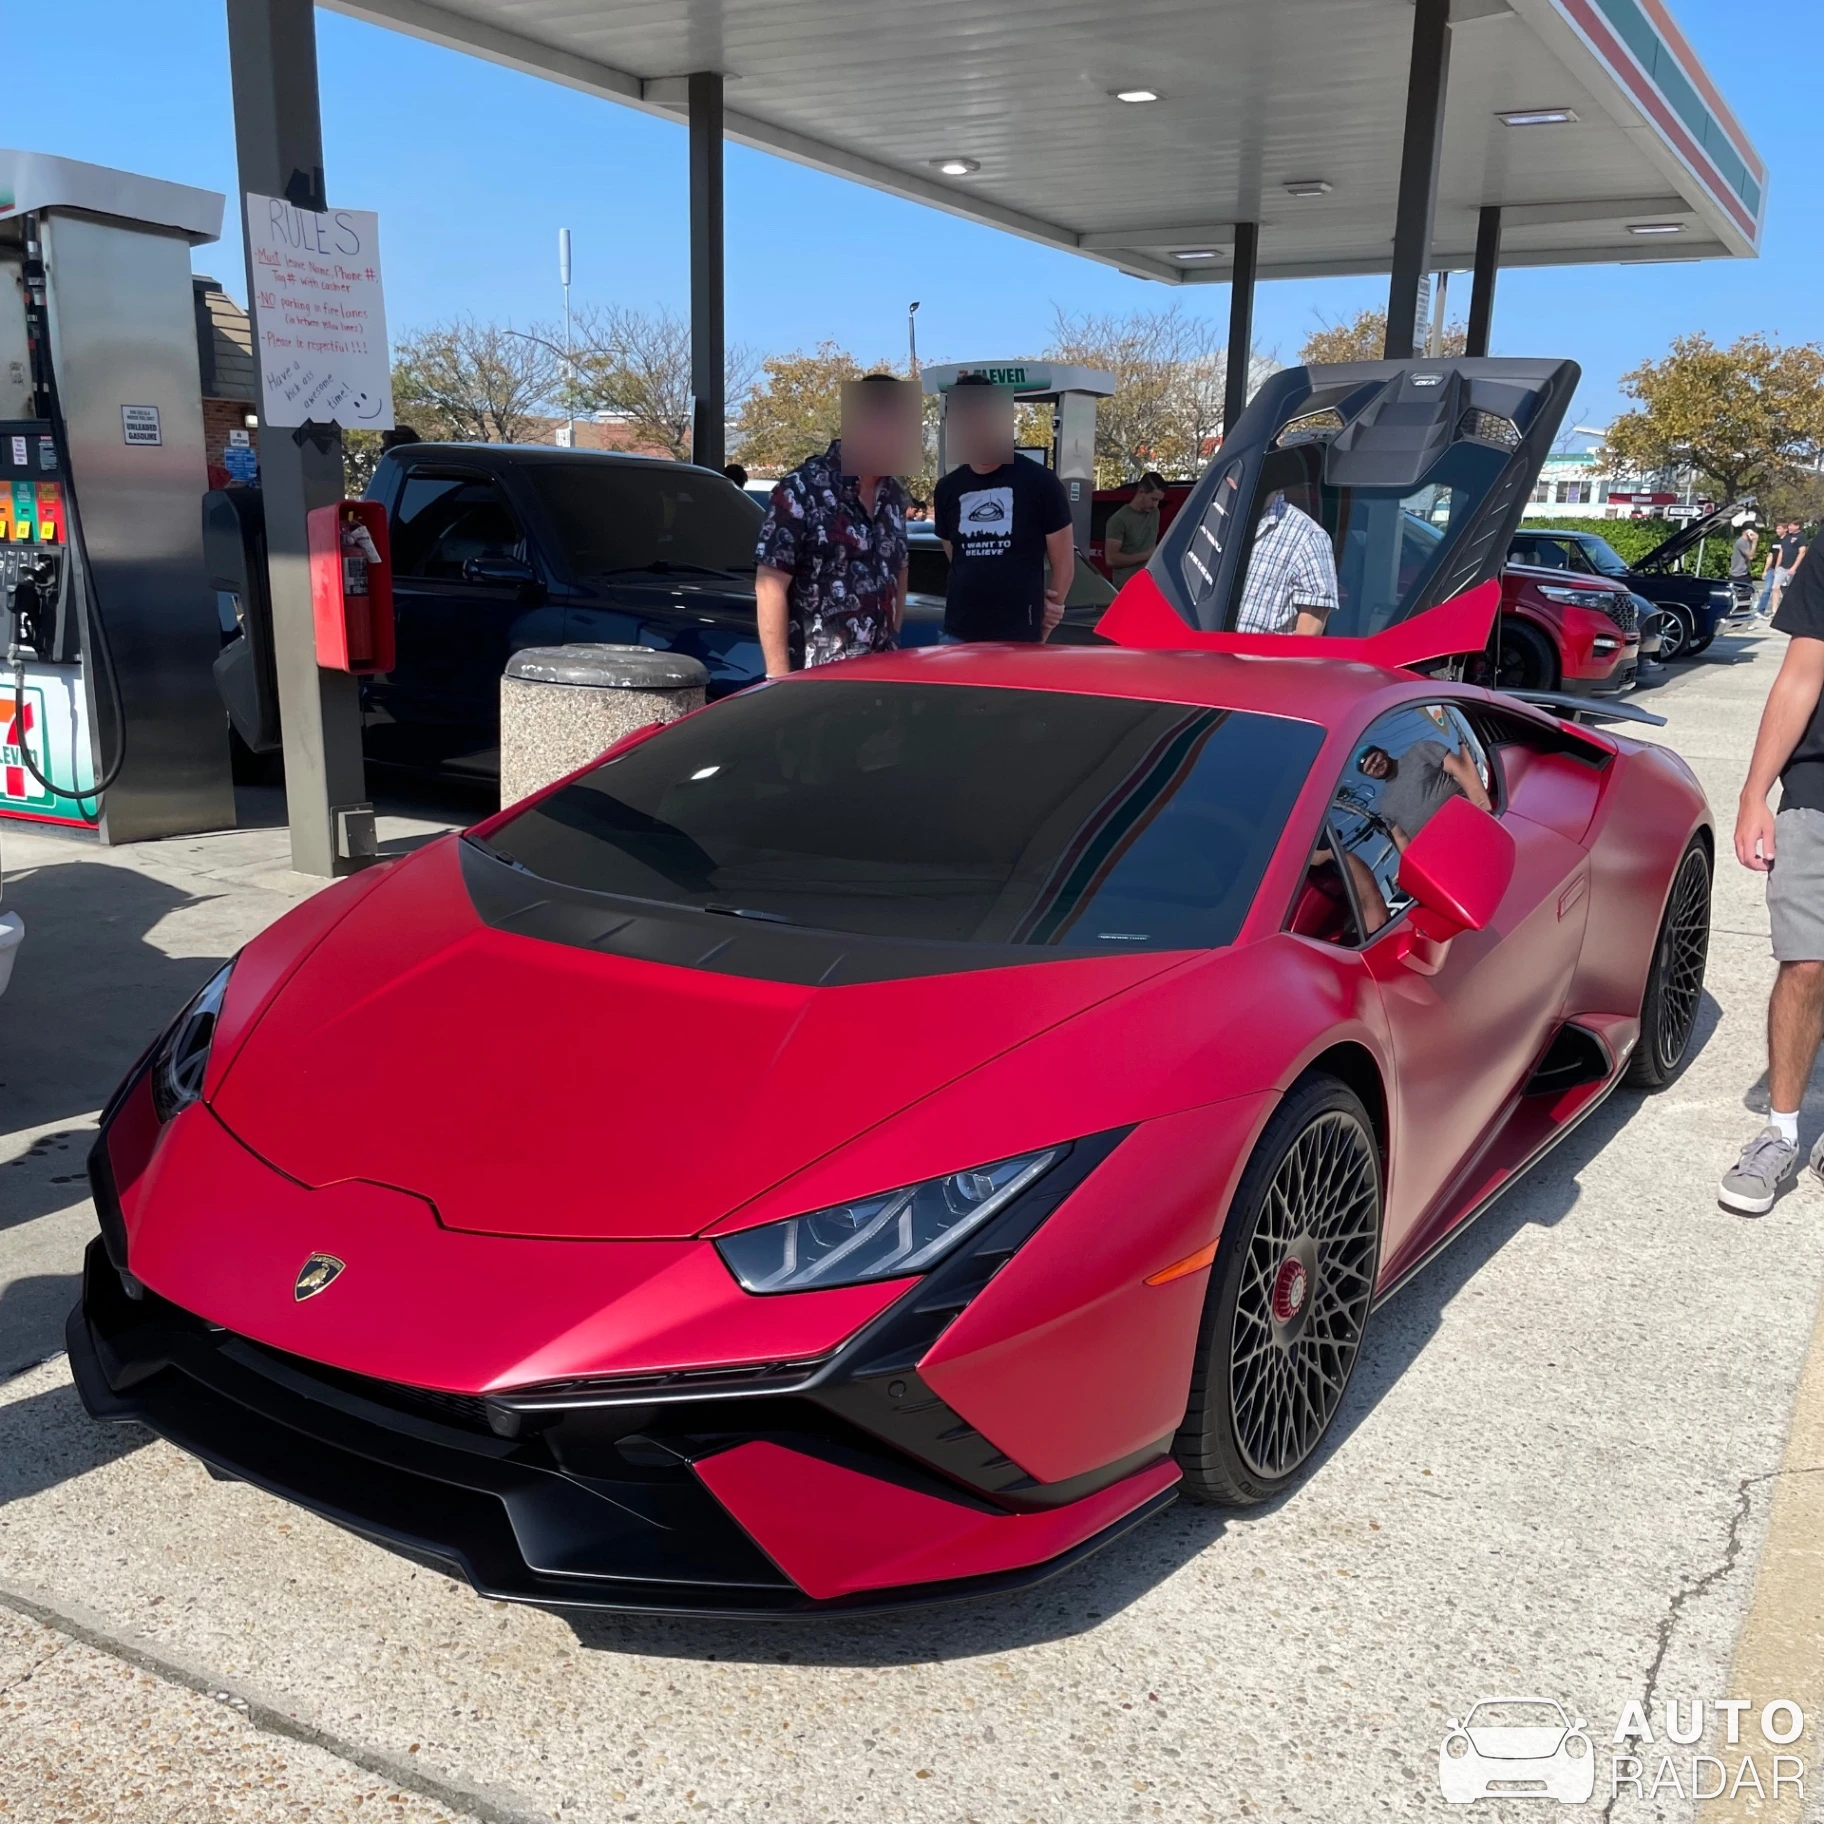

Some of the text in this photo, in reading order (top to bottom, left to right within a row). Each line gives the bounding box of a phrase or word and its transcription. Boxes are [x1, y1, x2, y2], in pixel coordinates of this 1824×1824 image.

[268, 198, 360, 256] RULES
[284, 252, 306, 271] leave
[334, 264, 363, 281] Phone
[300, 276, 319, 289] with
[321, 280, 351, 294] cashier
[280, 297, 311, 316] parking
[296, 336, 304, 348] be
[266, 360, 301, 392] Have a
[284, 370, 315, 402] kick ass
[304, 373, 333, 409] awesome
[326, 381, 353, 410] time!
[126, 423, 158, 432] UNLEADED
[128, 432, 158, 441] GASOLINE
[965, 548, 1005, 557] BELIEVE
[967, 540, 996, 549] WANT
[997, 540, 1012, 548] TO
